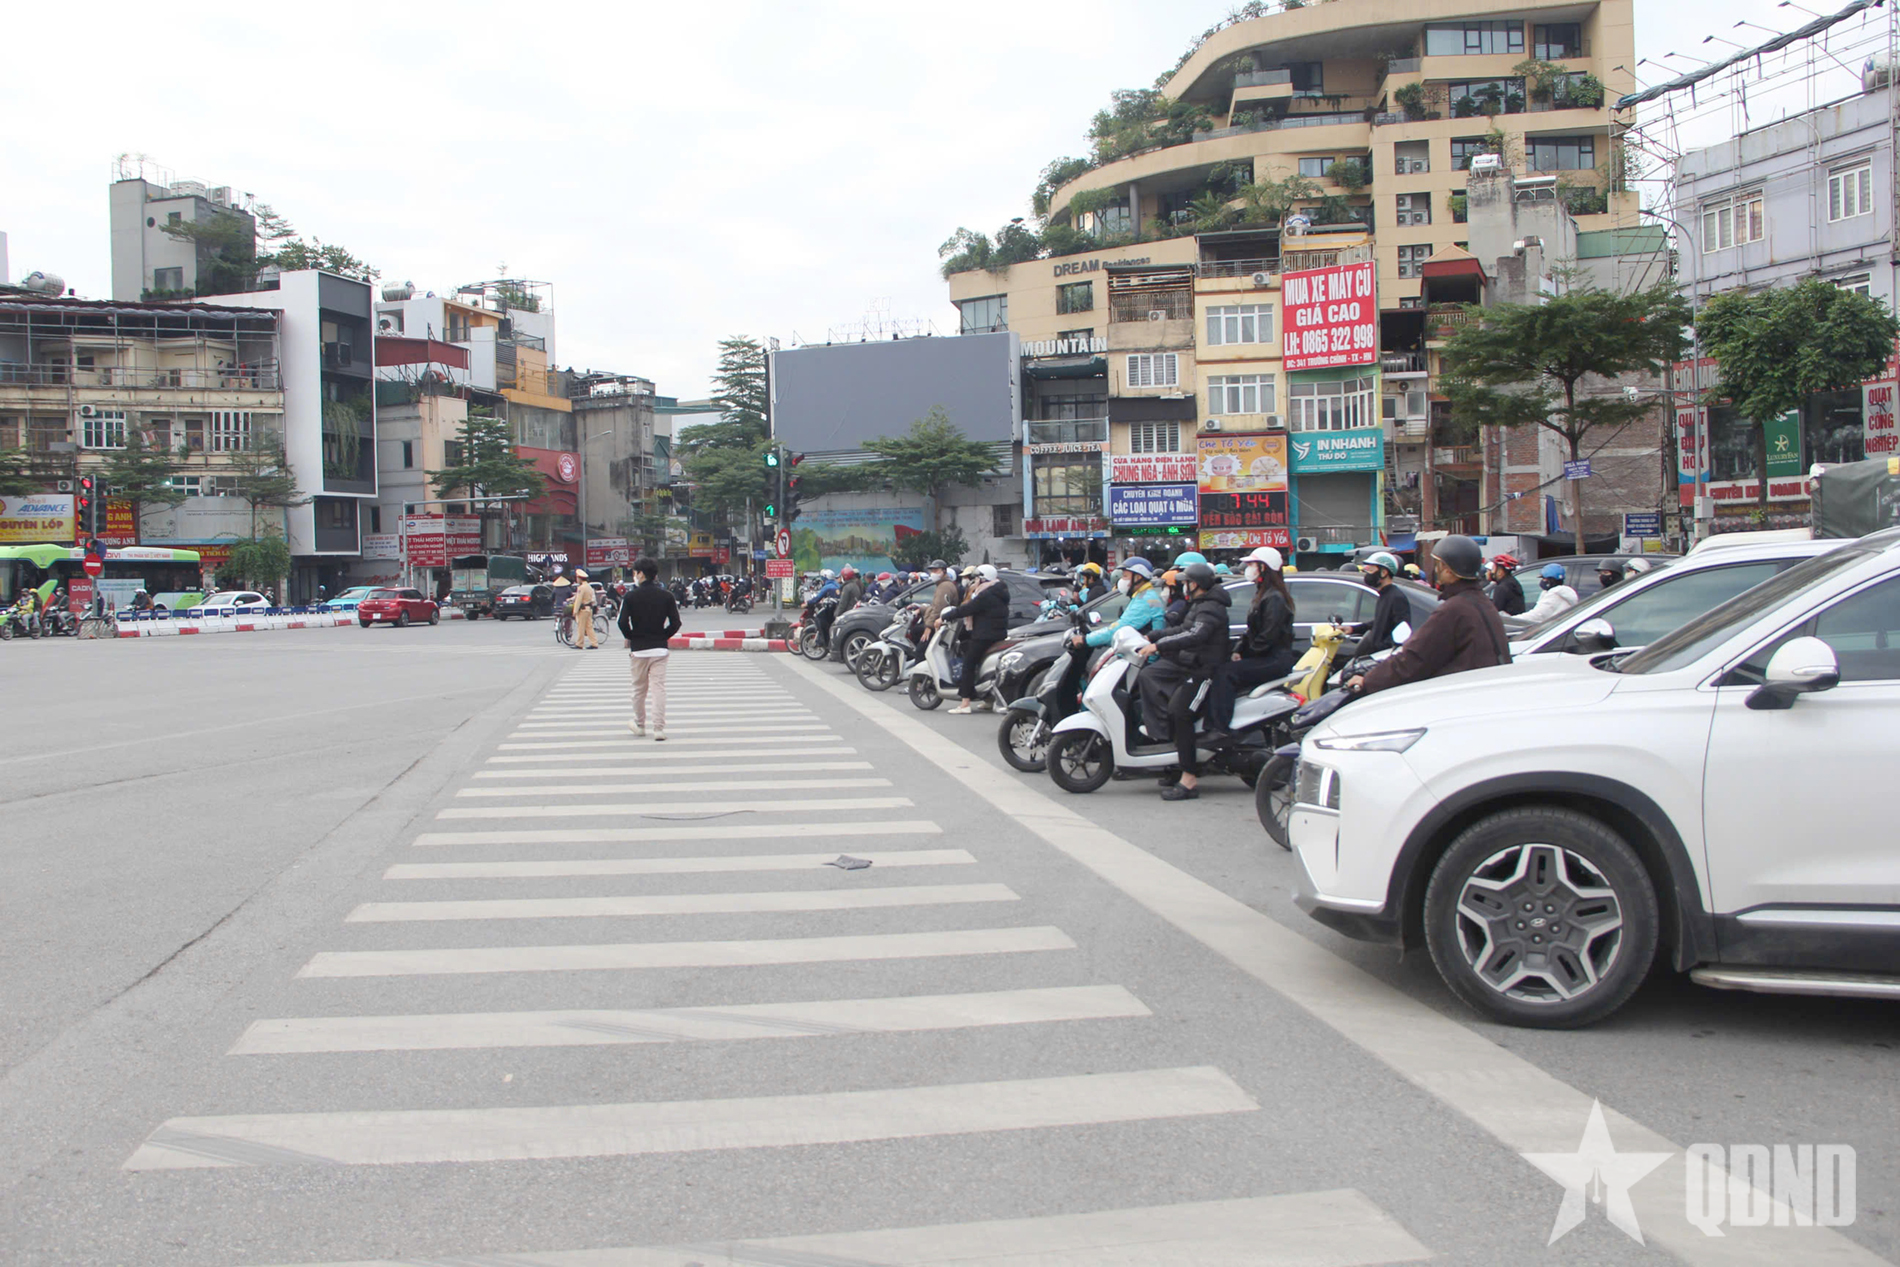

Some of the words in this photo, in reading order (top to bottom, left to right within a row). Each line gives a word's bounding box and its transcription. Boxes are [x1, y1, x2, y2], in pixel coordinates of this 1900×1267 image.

[1053, 259, 1100, 277] DREAM
[1284, 277, 1309, 306] MUA
[1311, 275, 1326, 303] XE
[1328, 266, 1353, 301] MÁY
[1355, 263, 1371, 297] CŨ
[1296, 303, 1323, 327] GIÁ
[1328, 302, 1360, 323] CAO
[1020, 337, 1108, 357] MOUNTAIN
[1284, 332, 1300, 356] LH:
[1302, 328, 1328, 354] 0865
[1331, 326, 1351, 352] 322
[1353, 323, 1374, 349] 998
[1296, 358, 1306, 367] 341
[1868, 386, 1892, 405] QUẠT
[1868, 412, 1894, 430] CÔNG
[1029, 446, 1059, 455] COFFEE
[1061, 444, 1083, 454] JUICE
[1087, 443, 1101, 452] TEA
[1317, 440, 1329, 451] IN
[1331, 437, 1377, 450] NHANH
[1864, 433, 1898, 454] NGHIỆP
[1113, 456, 1128, 464] CỬA
[1130, 456, 1153, 464] HÀNG
[1318, 450, 1332, 460] THỦ
[1113, 464, 1139, 481] CHUNG
[1180, 462, 1196, 480] SƠN
[1123, 489, 1146, 499] CHUYÊN
[1147, 489, 1162, 498] KINH
[1163, 488, 1183, 497] DOANH
[1709, 484, 1743, 499] CHUYÊN
[1769, 481, 1801, 496] DOANH
[17, 503, 69, 513] ADVANCE
[1112, 500, 1128, 515] CÁC
[1129, 501, 1147, 516] LOẠI
[1148, 501, 1168, 516] QUẠT
[1169, 501, 1175, 513] 4
[1176, 498, 1195, 512] MÙA
[0, 519, 38, 530] GUYÊN
[42, 518, 64, 530] LỐP
[1203, 510, 1221, 526] YẾN
[1224, 510, 1243, 526] SÀO
[1264, 509, 1284, 524] GÒN
[123, 537, 136, 546] ANH
[427, 535, 444, 543] MOTOR
[1249, 533, 1262, 545] Chè
[1263, 530, 1273, 545] Tổ
[1274, 529, 1288, 544] Yến
